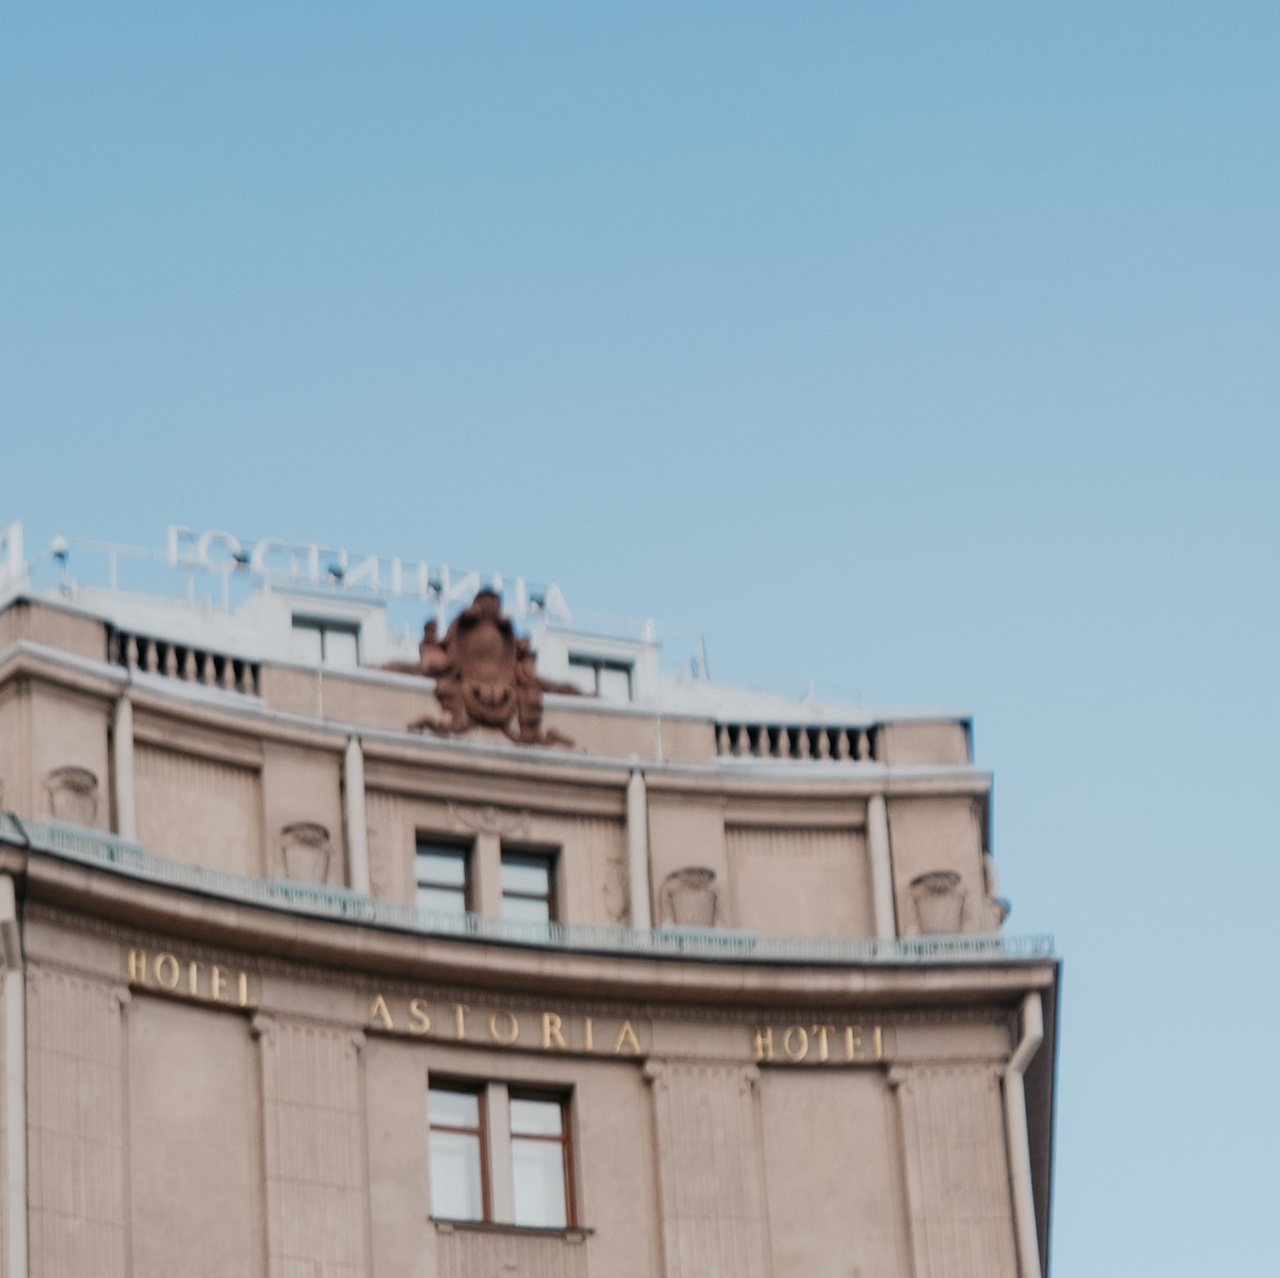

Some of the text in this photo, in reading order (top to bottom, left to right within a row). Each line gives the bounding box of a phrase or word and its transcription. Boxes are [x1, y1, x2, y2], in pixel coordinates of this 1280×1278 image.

[128, 949, 258, 1008] HOTEL
[370, 993, 642, 1056] ASTORIA
[755, 1025, 886, 1063] HOTEL
